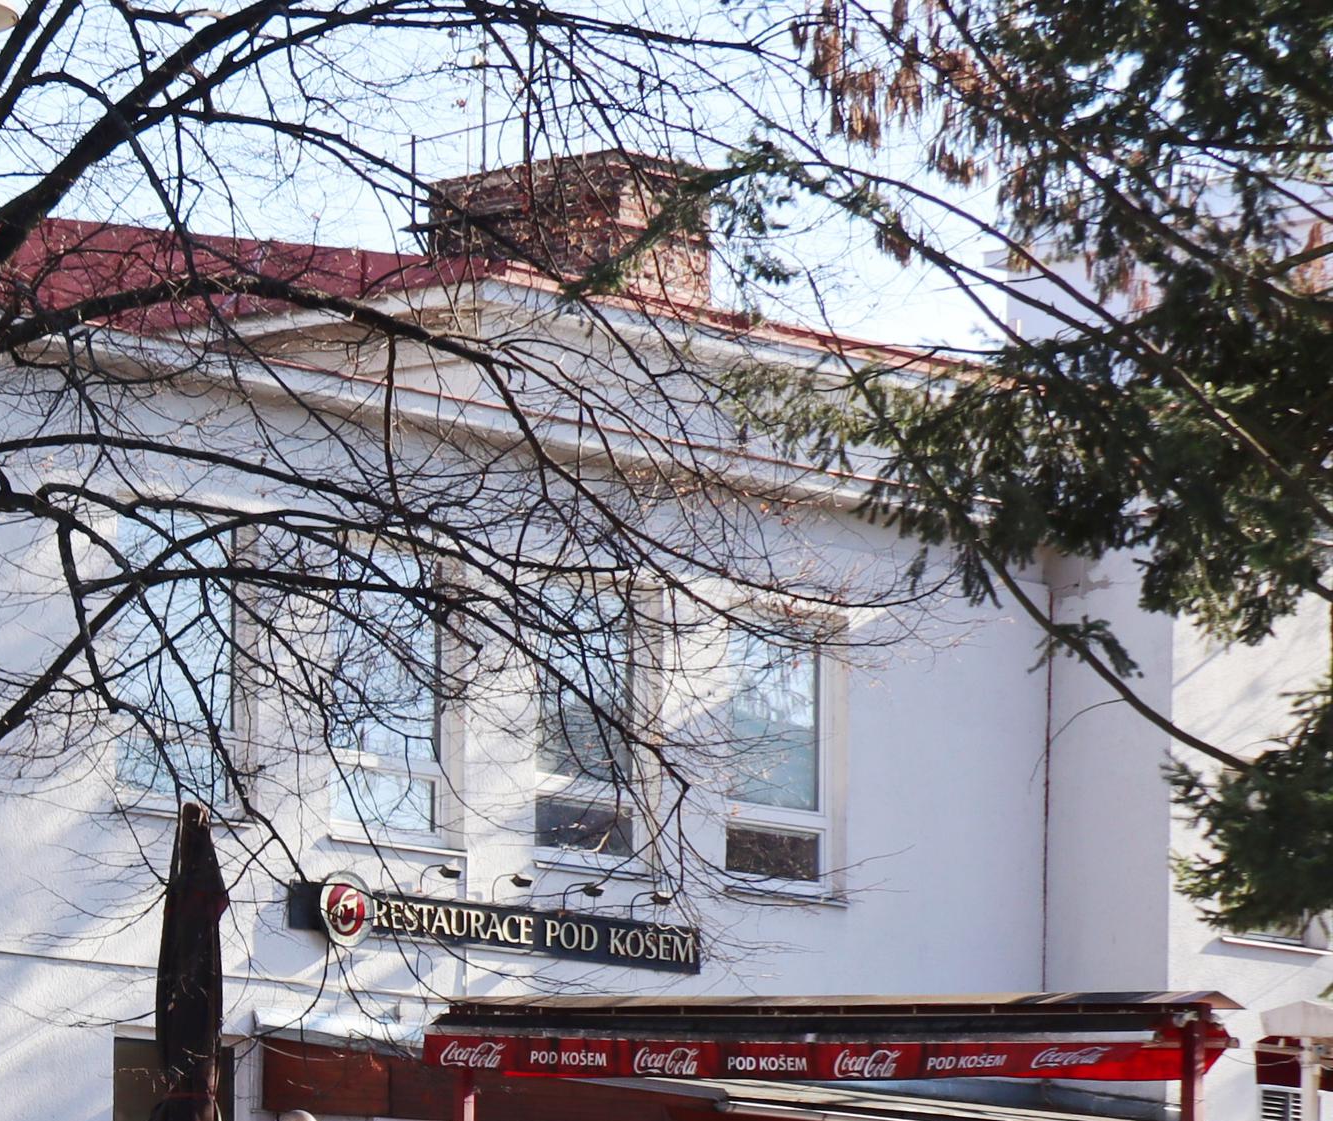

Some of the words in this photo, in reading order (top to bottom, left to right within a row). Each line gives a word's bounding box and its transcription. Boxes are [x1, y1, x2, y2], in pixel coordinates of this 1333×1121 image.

[372, 897, 533, 945] RESTAURACE
[545, 919, 598, 951] POD
[609, 924, 695, 964] KOŠEM
[530, 1050, 558, 1065] POD
[561, 1045, 607, 1067] KOŠEM
[728, 1056, 756, 1071] POD
[759, 1053, 807, 1071] KOŠEM
[926, 1055, 954, 1070] POD
[958, 1052, 1007, 1069] KOŠEM
